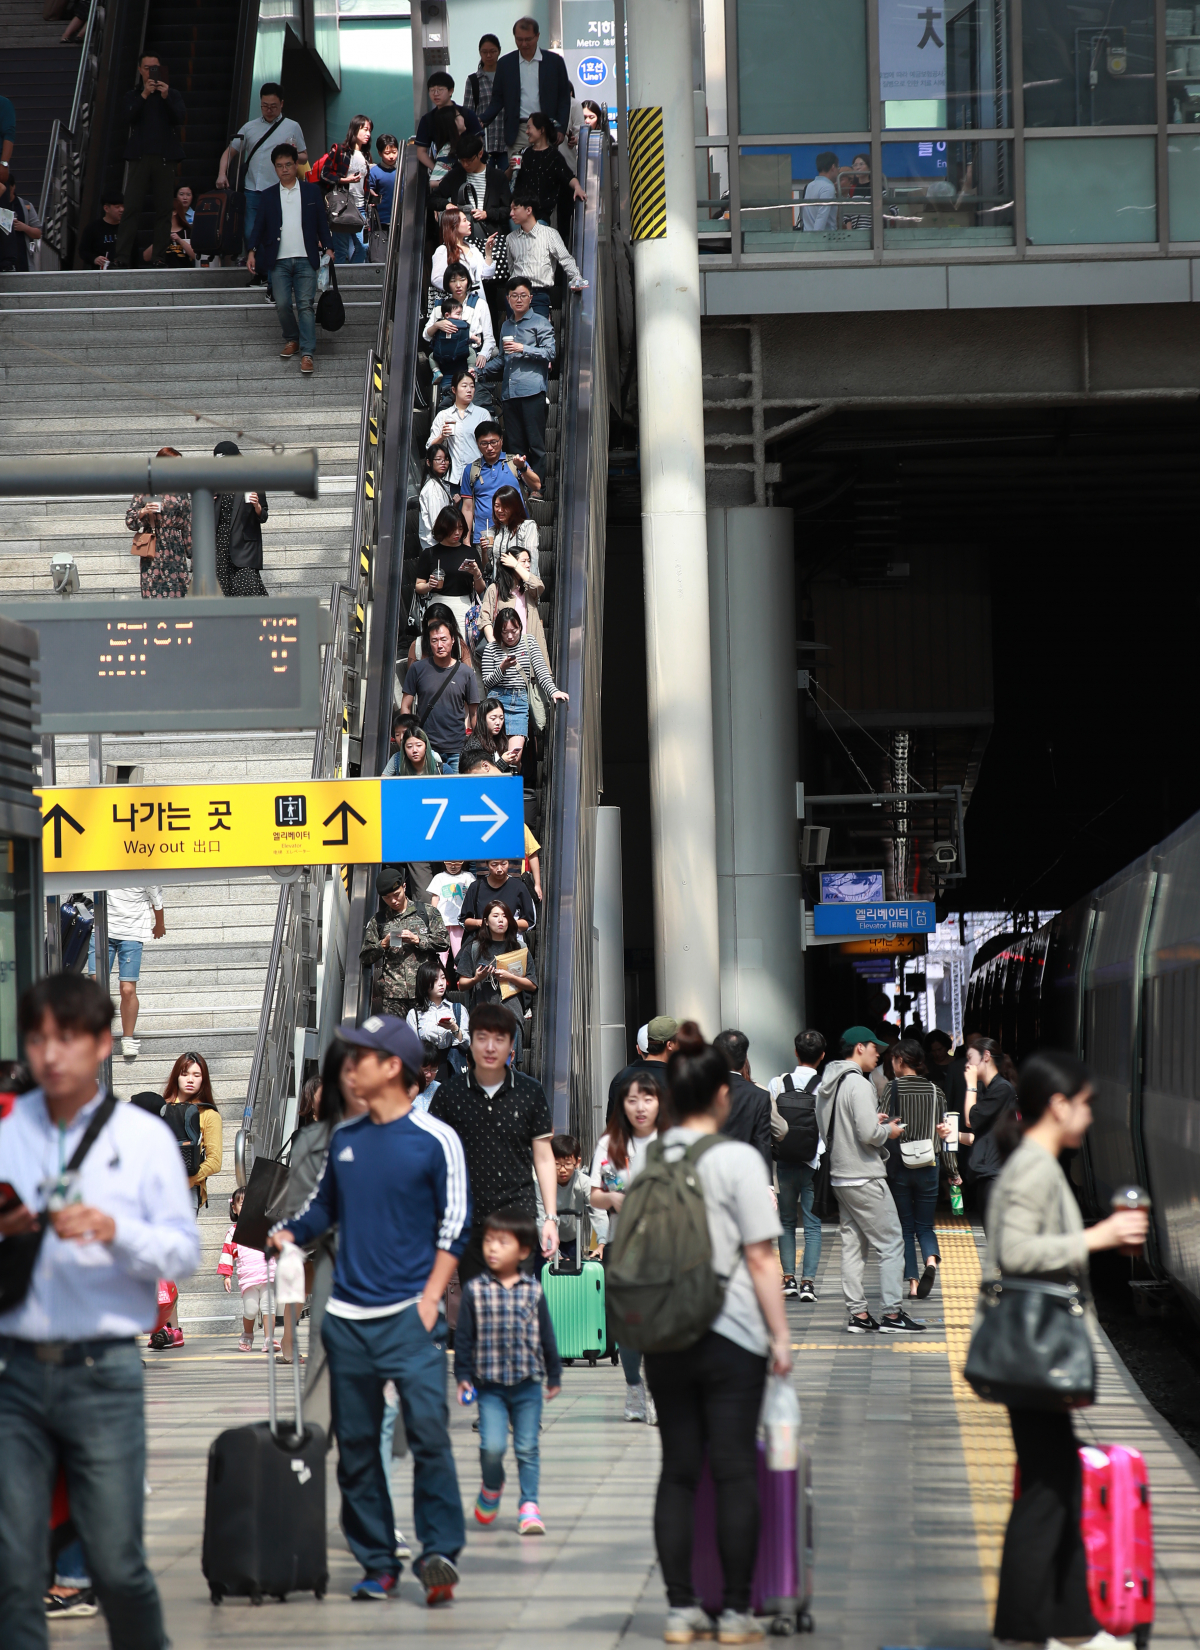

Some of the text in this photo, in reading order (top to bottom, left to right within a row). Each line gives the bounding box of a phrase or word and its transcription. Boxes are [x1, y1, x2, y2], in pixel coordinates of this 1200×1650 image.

[588, 20, 627, 37] 지하
[576, 38, 600, 47] Metro
[580, 62, 603, 73] 1호선
[113, 801, 232, 832] 나가는 곳
[422, 798, 449, 840] 7
[273, 831, 310, 841] 엘리베이터
[124, 839, 221, 857] Way out 出口
[855, 908, 909, 921] 엘리베이터
